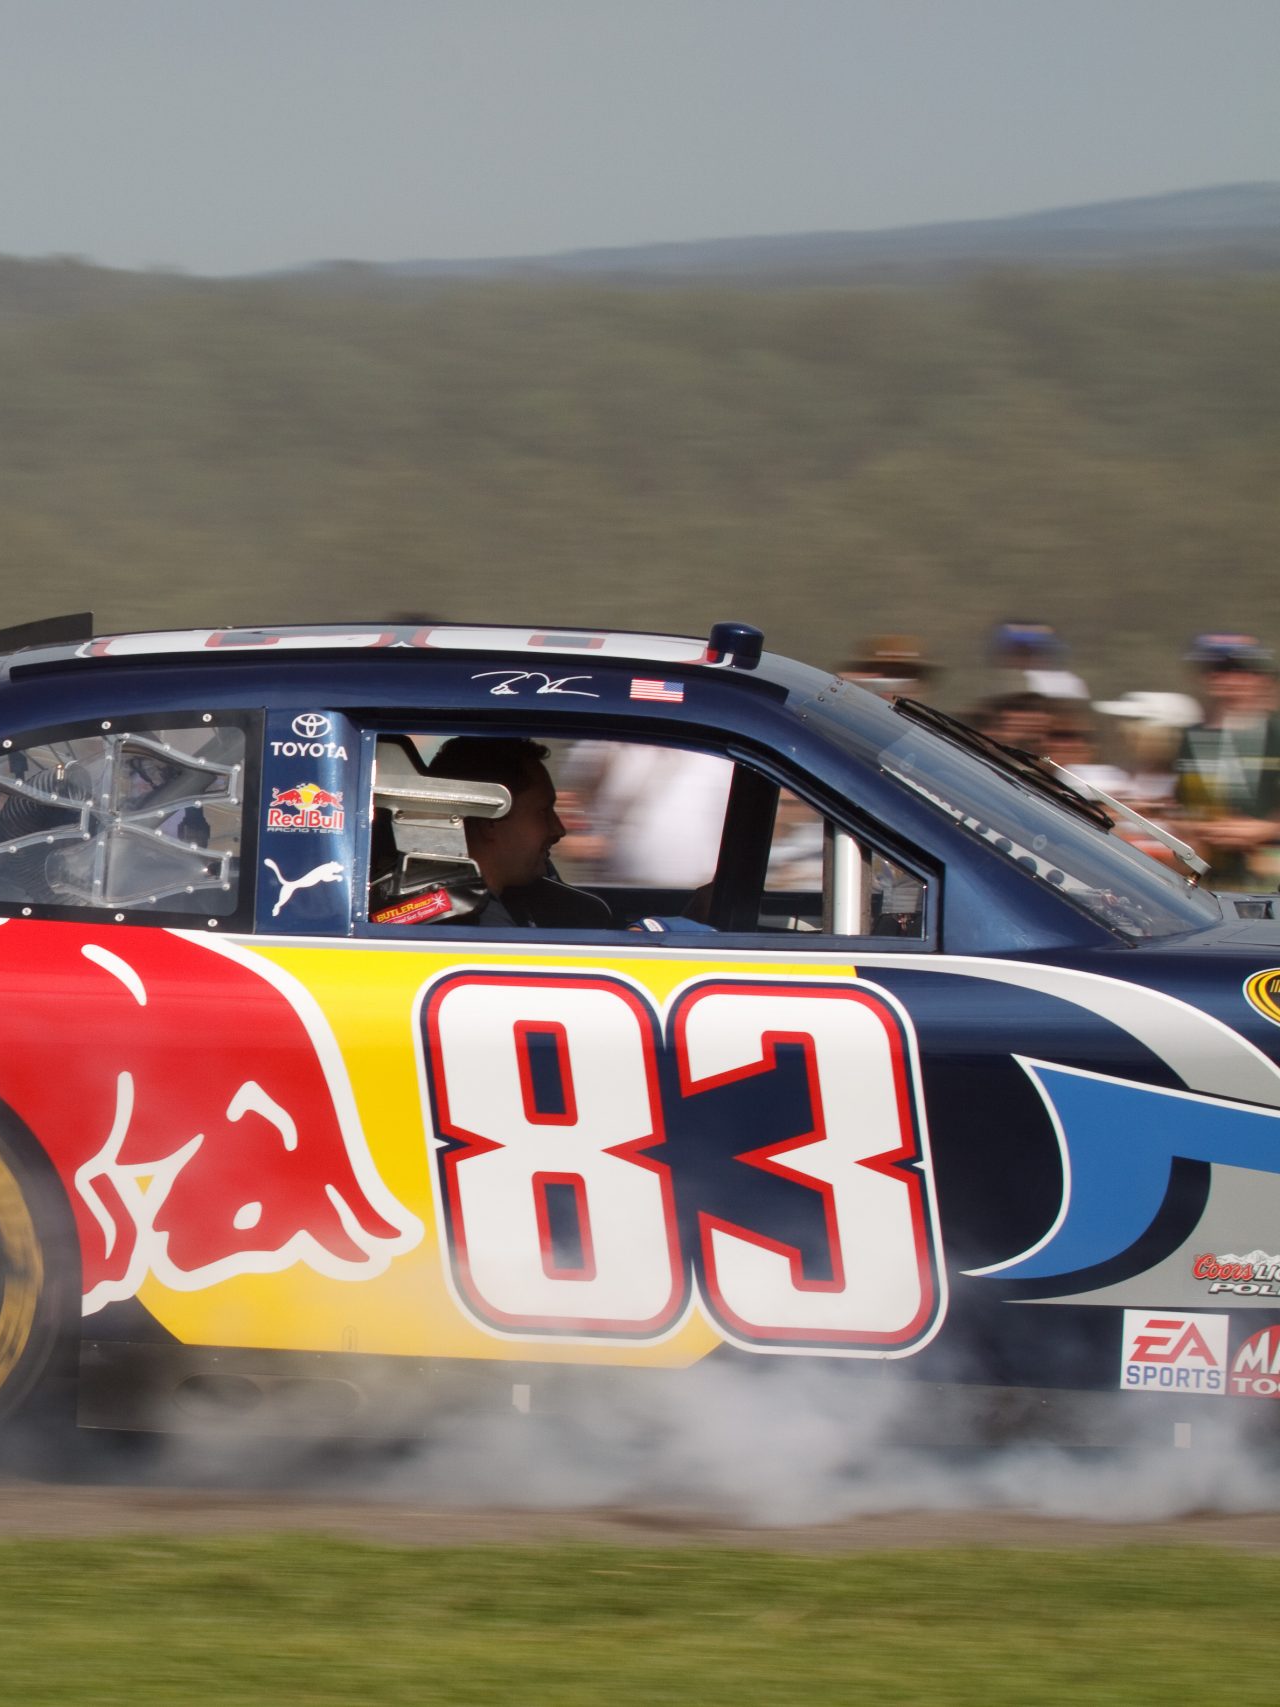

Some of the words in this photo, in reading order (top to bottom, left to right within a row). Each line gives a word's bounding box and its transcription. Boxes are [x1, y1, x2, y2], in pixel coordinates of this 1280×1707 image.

[270, 741, 348, 761] TOYOTA
[268, 808, 306, 827] Red
[307, 810, 345, 830] Bull
[412, 964, 948, 1359] 83
[1193, 1253, 1254, 1281] Coors
[1208, 1283, 1280, 1297] POL
[1129, 1319, 1218, 1366] EA
[1126, 1365, 1220, 1390] SPORTS
[1232, 1377, 1280, 1395] TO
